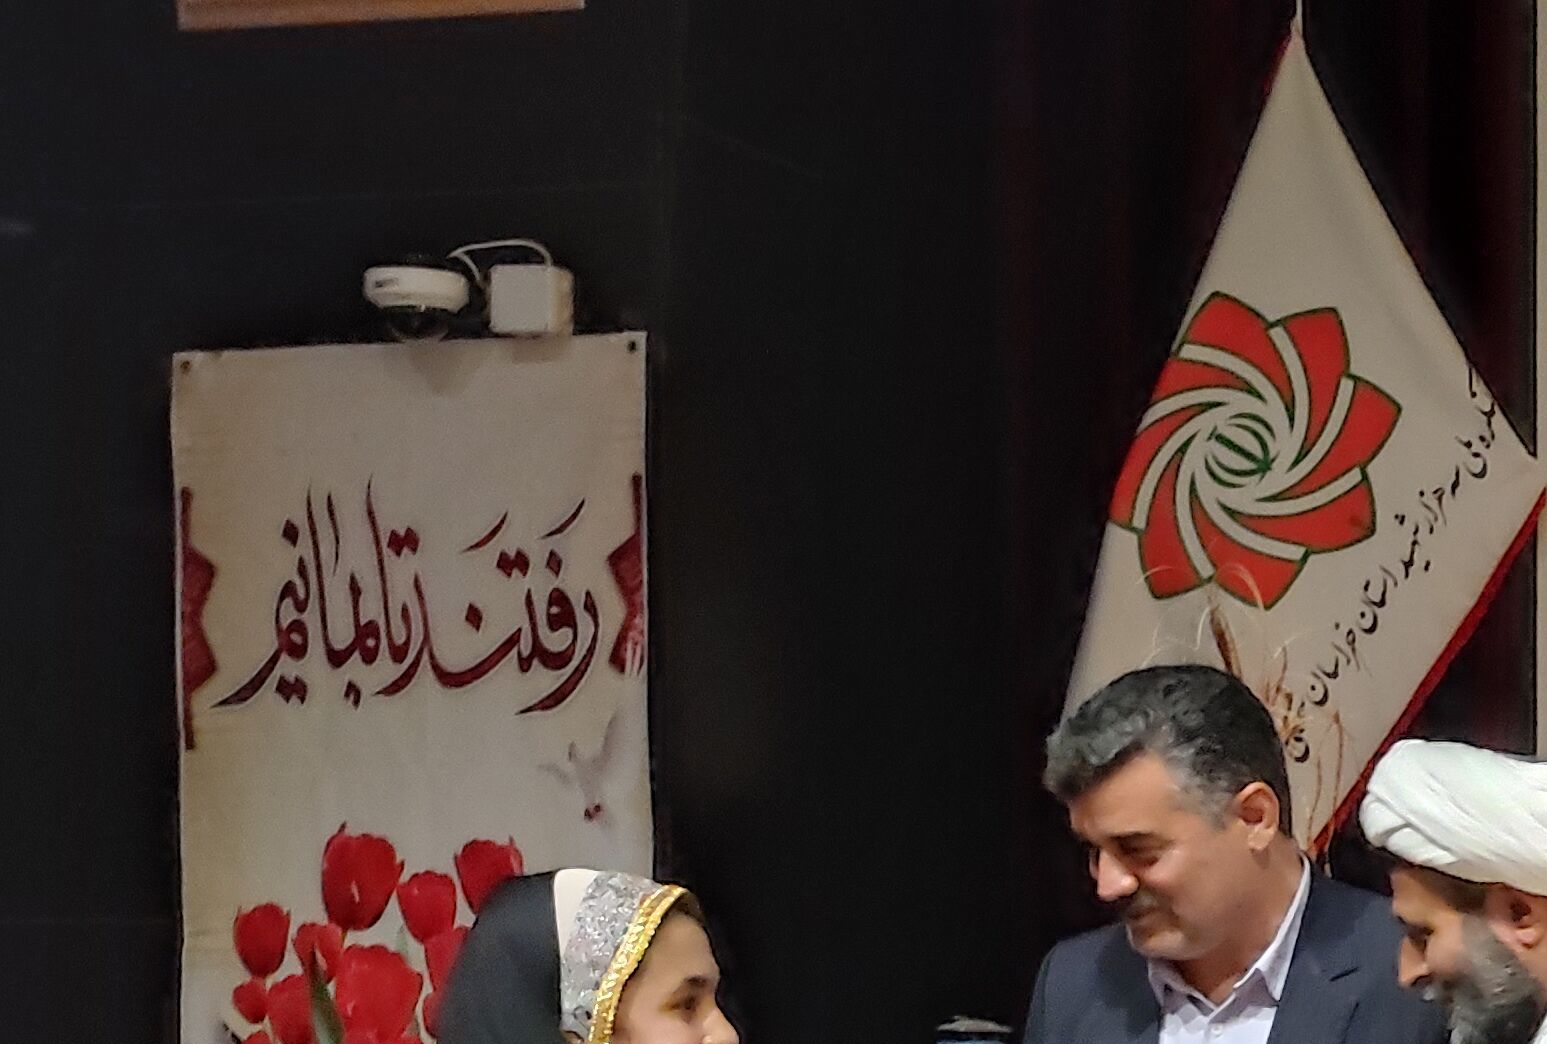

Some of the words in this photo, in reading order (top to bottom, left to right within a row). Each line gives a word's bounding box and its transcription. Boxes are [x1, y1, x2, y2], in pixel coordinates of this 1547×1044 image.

[1394, 513, 1431, 580] شهید
[1357, 565, 1398, 634] استان
[1308, 620, 1361, 707] خراسان
